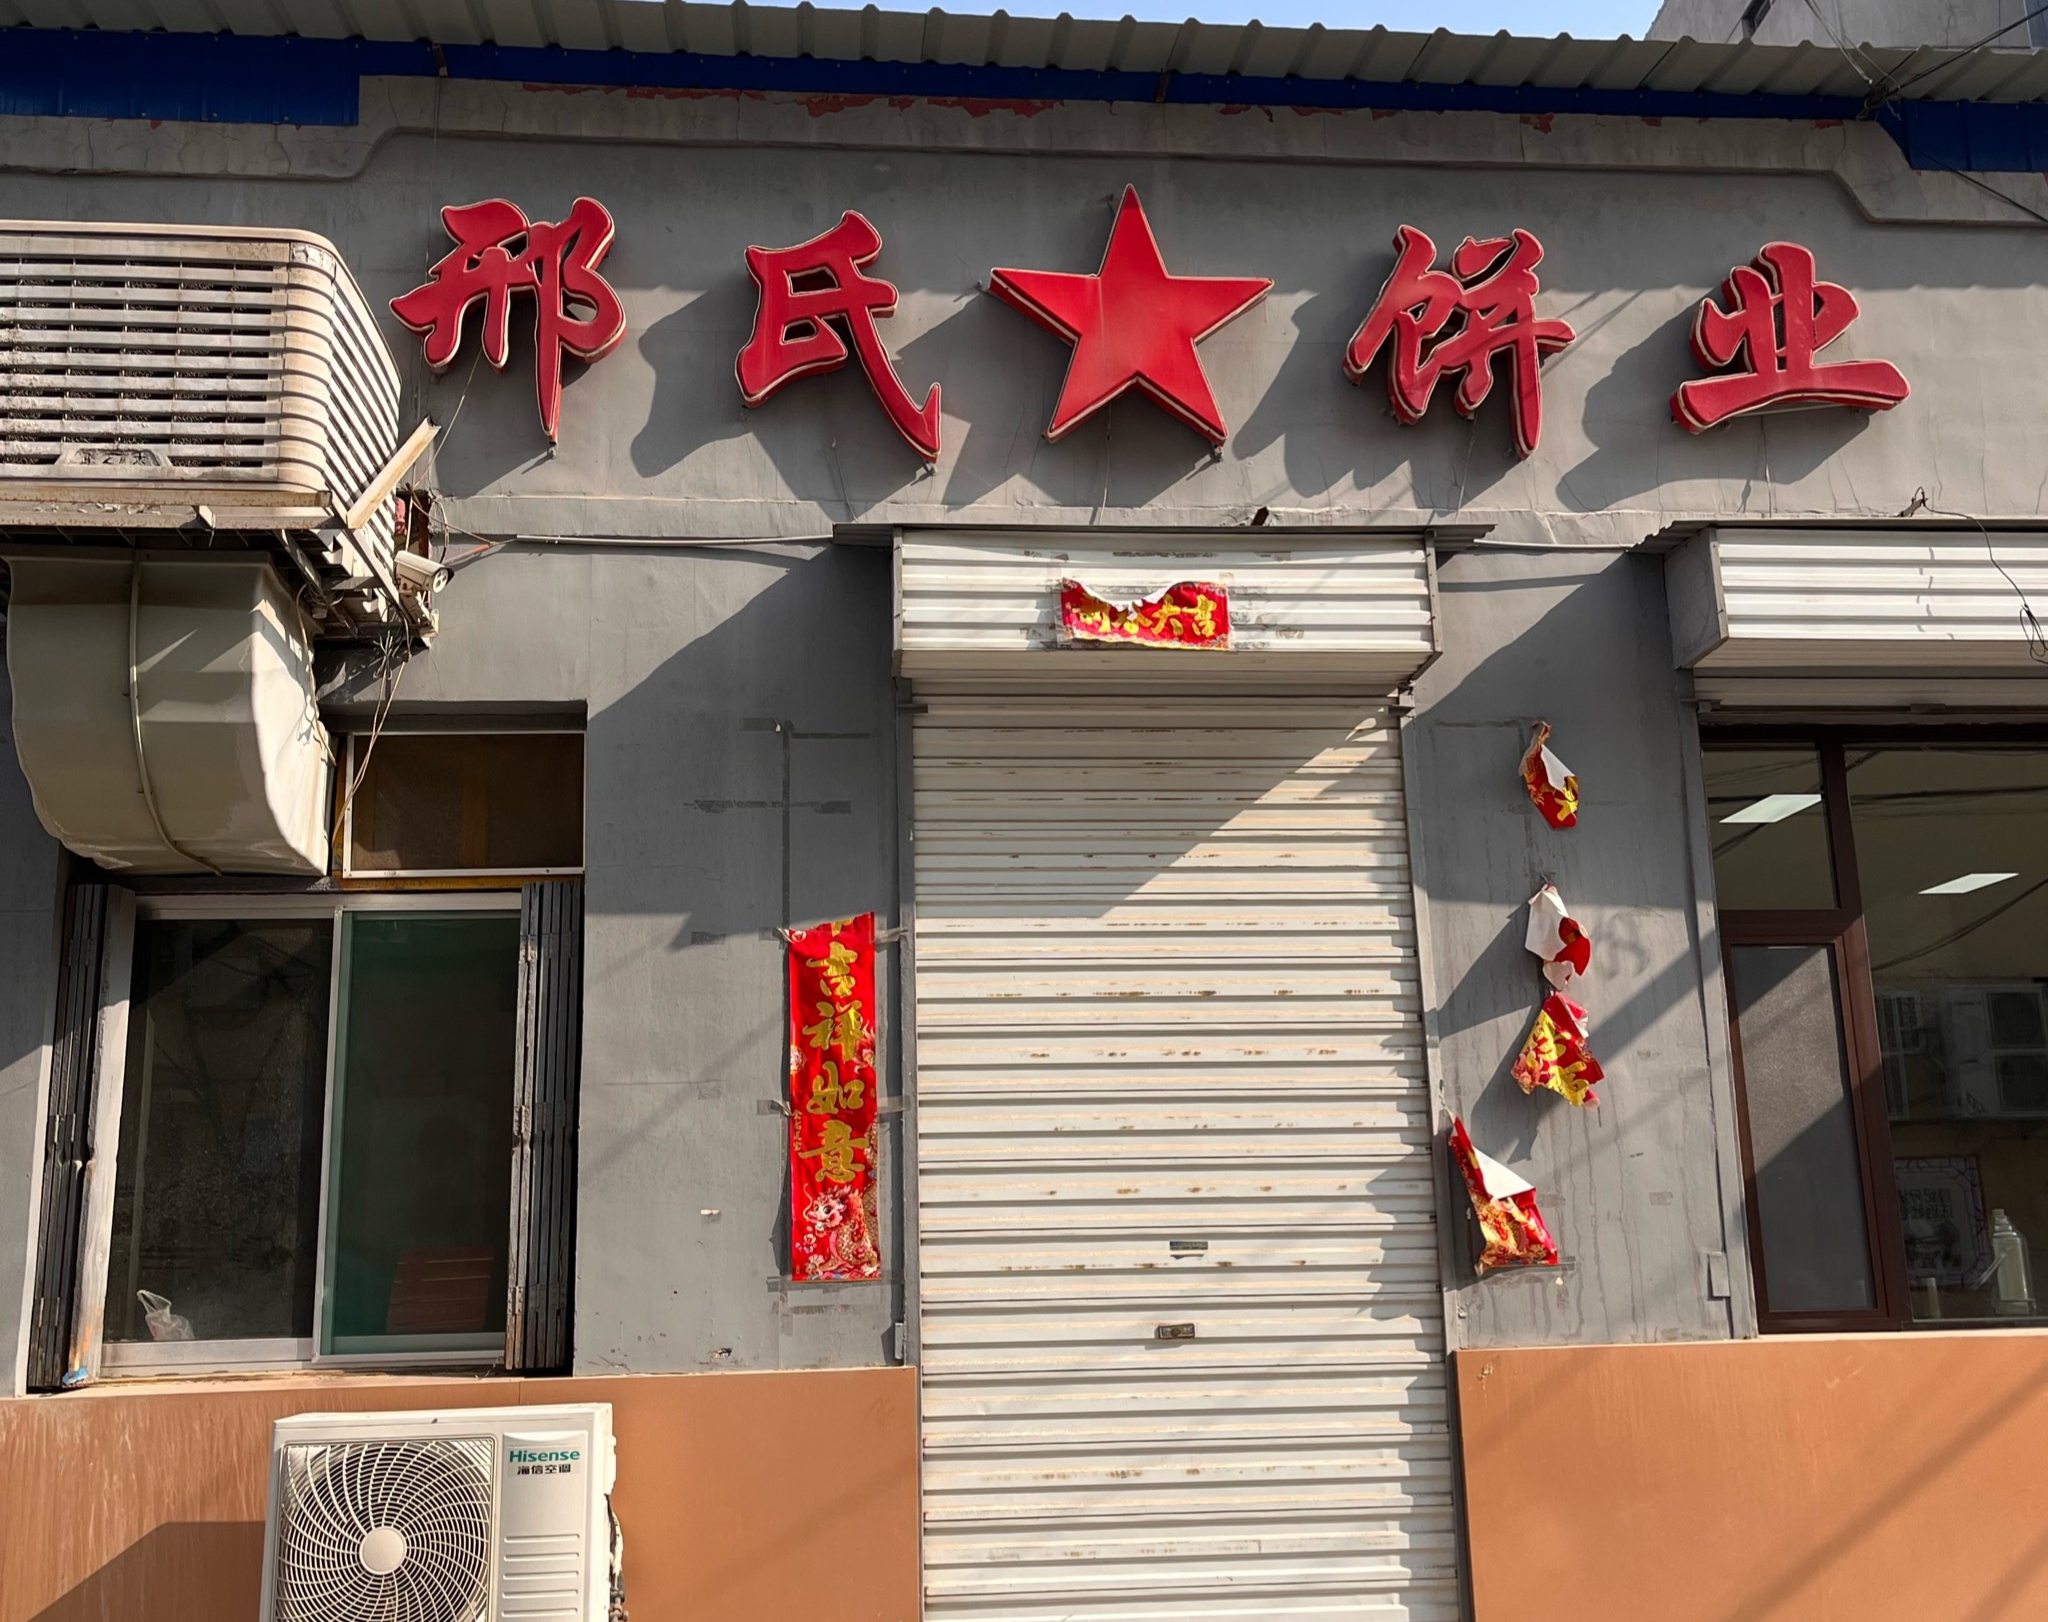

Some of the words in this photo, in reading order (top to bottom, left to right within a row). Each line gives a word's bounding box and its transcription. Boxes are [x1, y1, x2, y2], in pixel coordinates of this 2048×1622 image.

[389, 196, 942, 463] 邢氏
[1342, 224, 1911, 459] 饼业
[799, 918, 870, 1184] 吉祥如意
[509, 1450, 580, 1462] Hisense
[517, 1463, 571, 1475] 海信空调
